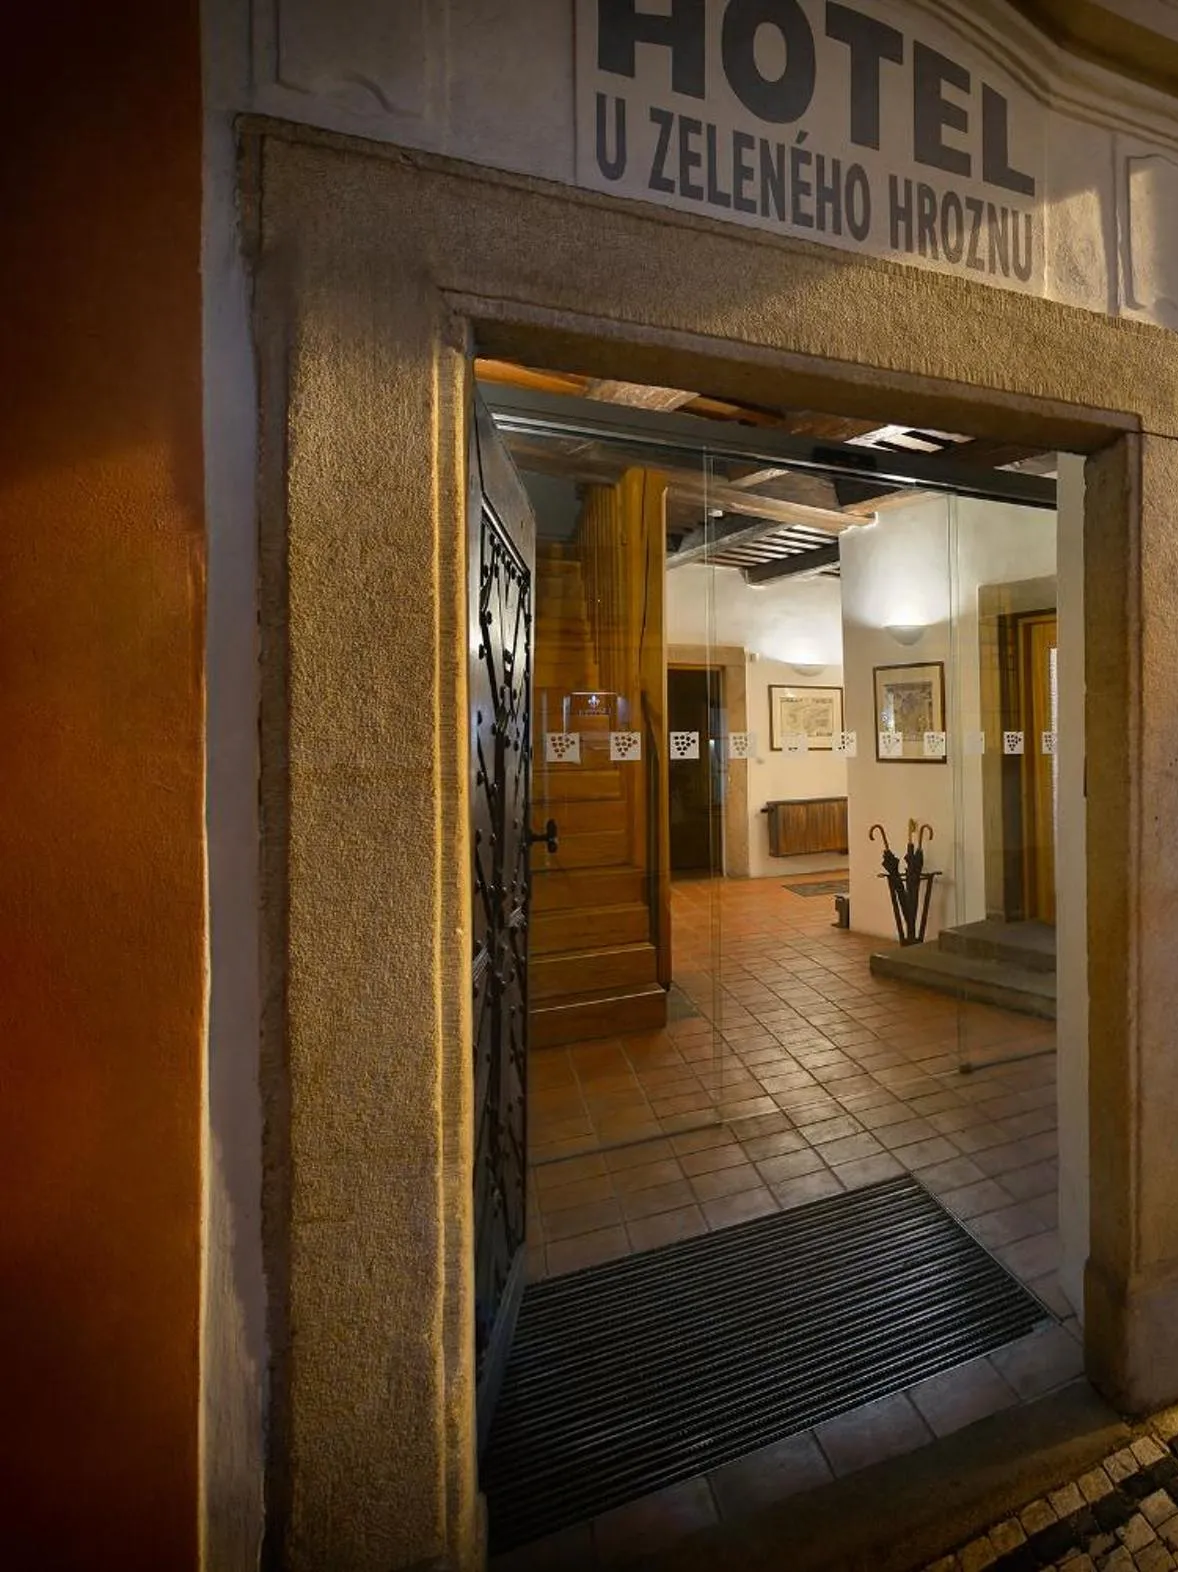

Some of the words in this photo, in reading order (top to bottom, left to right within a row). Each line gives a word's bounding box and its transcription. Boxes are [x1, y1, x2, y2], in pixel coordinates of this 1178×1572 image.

[596, 93, 627, 181] U
[649, 107, 871, 241] ZELENÉHO
[889, 174, 1032, 282] HROZNU
[598, 0, 1034, 195] HOTEL
